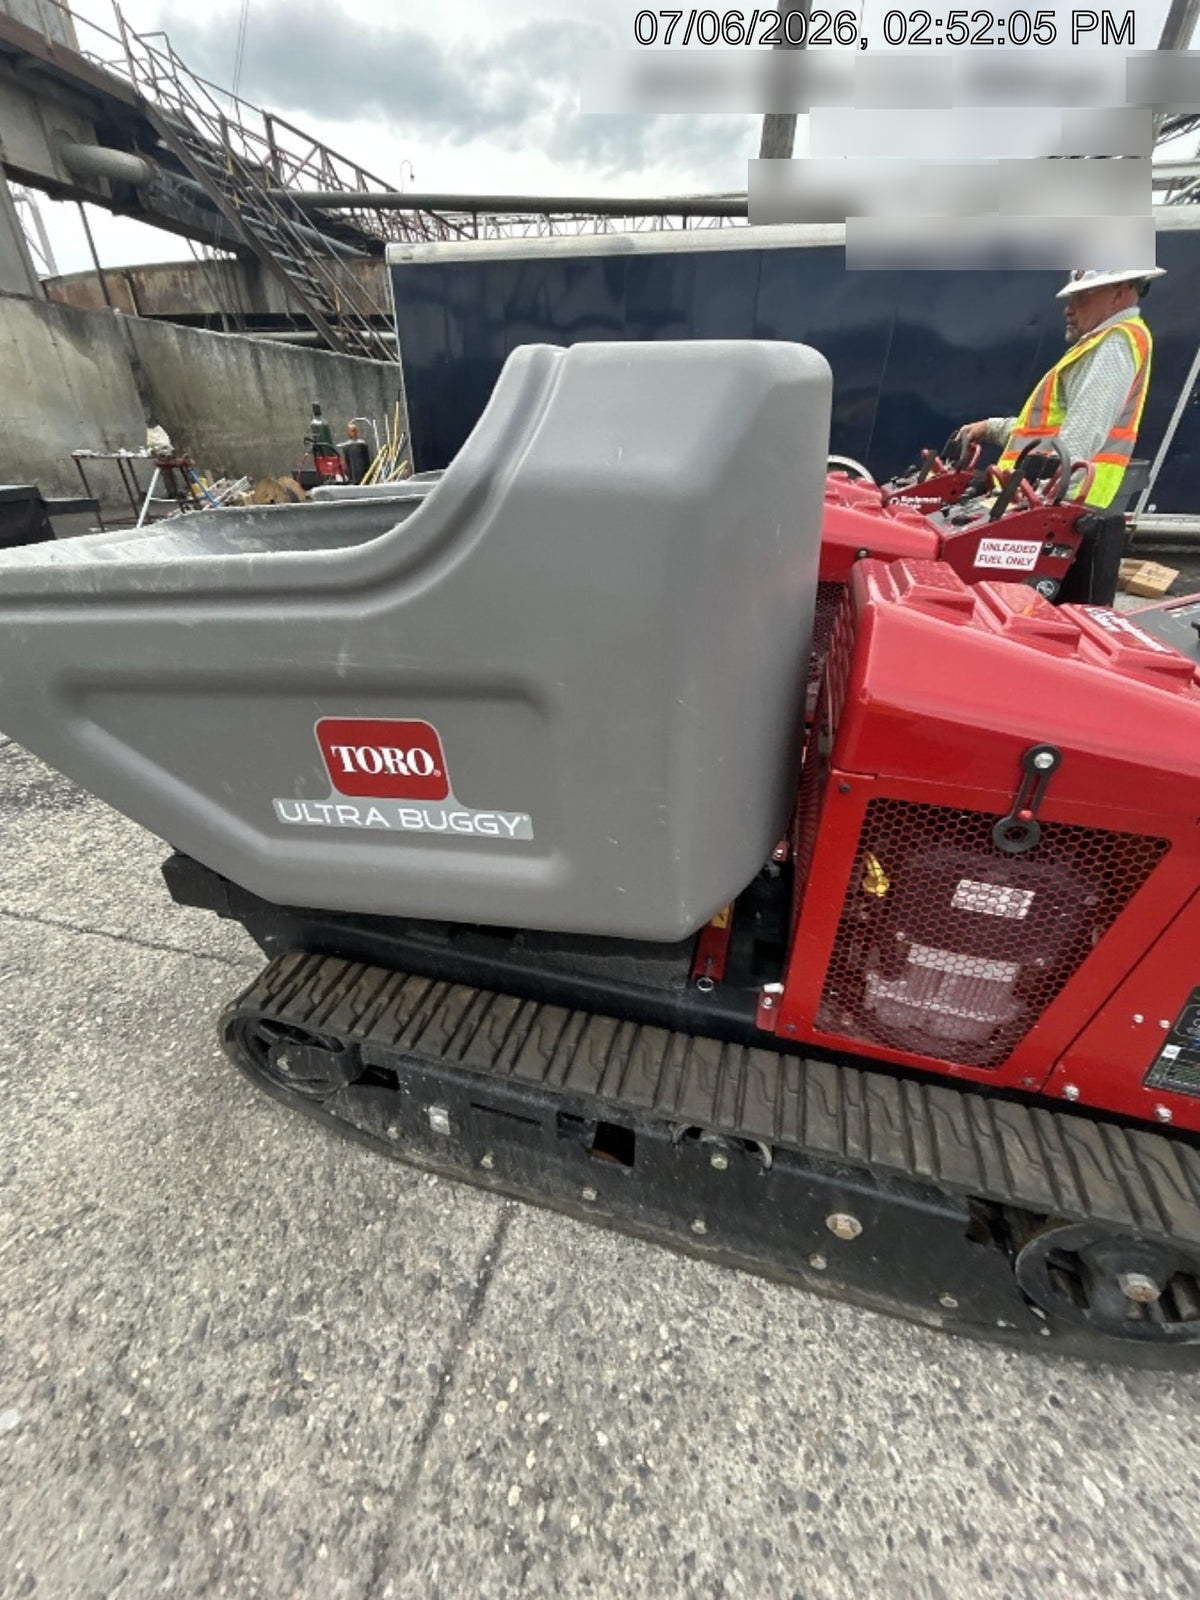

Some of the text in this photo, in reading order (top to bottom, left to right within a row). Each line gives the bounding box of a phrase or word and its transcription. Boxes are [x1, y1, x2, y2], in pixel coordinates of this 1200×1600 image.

[982, 542, 1038, 554] UNLEADED
[978, 554, 1034, 567] FUEL ONLY
[330, 745, 434, 776] TORO
[278, 801, 523, 836] ULTRA BUGGY
